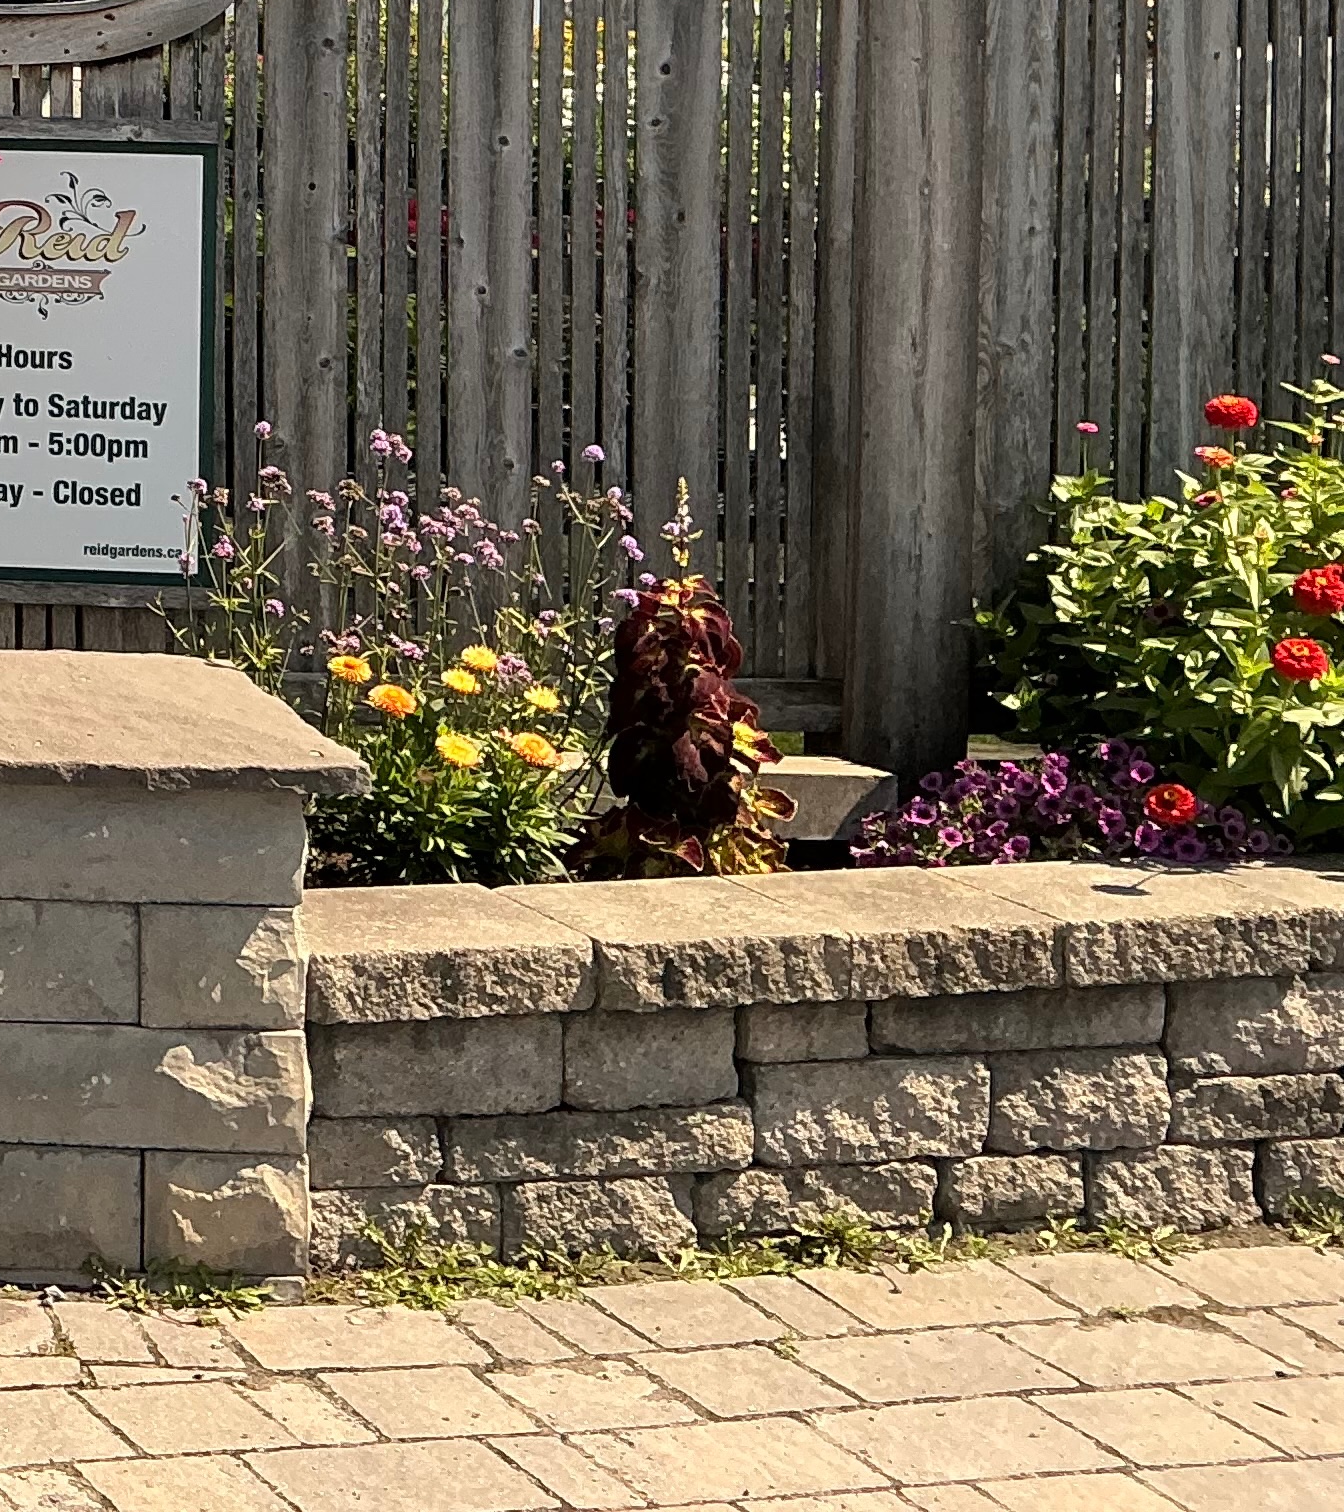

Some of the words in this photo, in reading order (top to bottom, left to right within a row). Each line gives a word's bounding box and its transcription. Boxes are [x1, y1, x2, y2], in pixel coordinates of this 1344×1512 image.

[13, 393, 39, 416] to
[47, 394, 167, 426] Saturday
[48, 433, 149, 462] 5:00pm
[52, 481, 142, 507] Closed
[83, 543, 183, 559] reidgardens.ca
